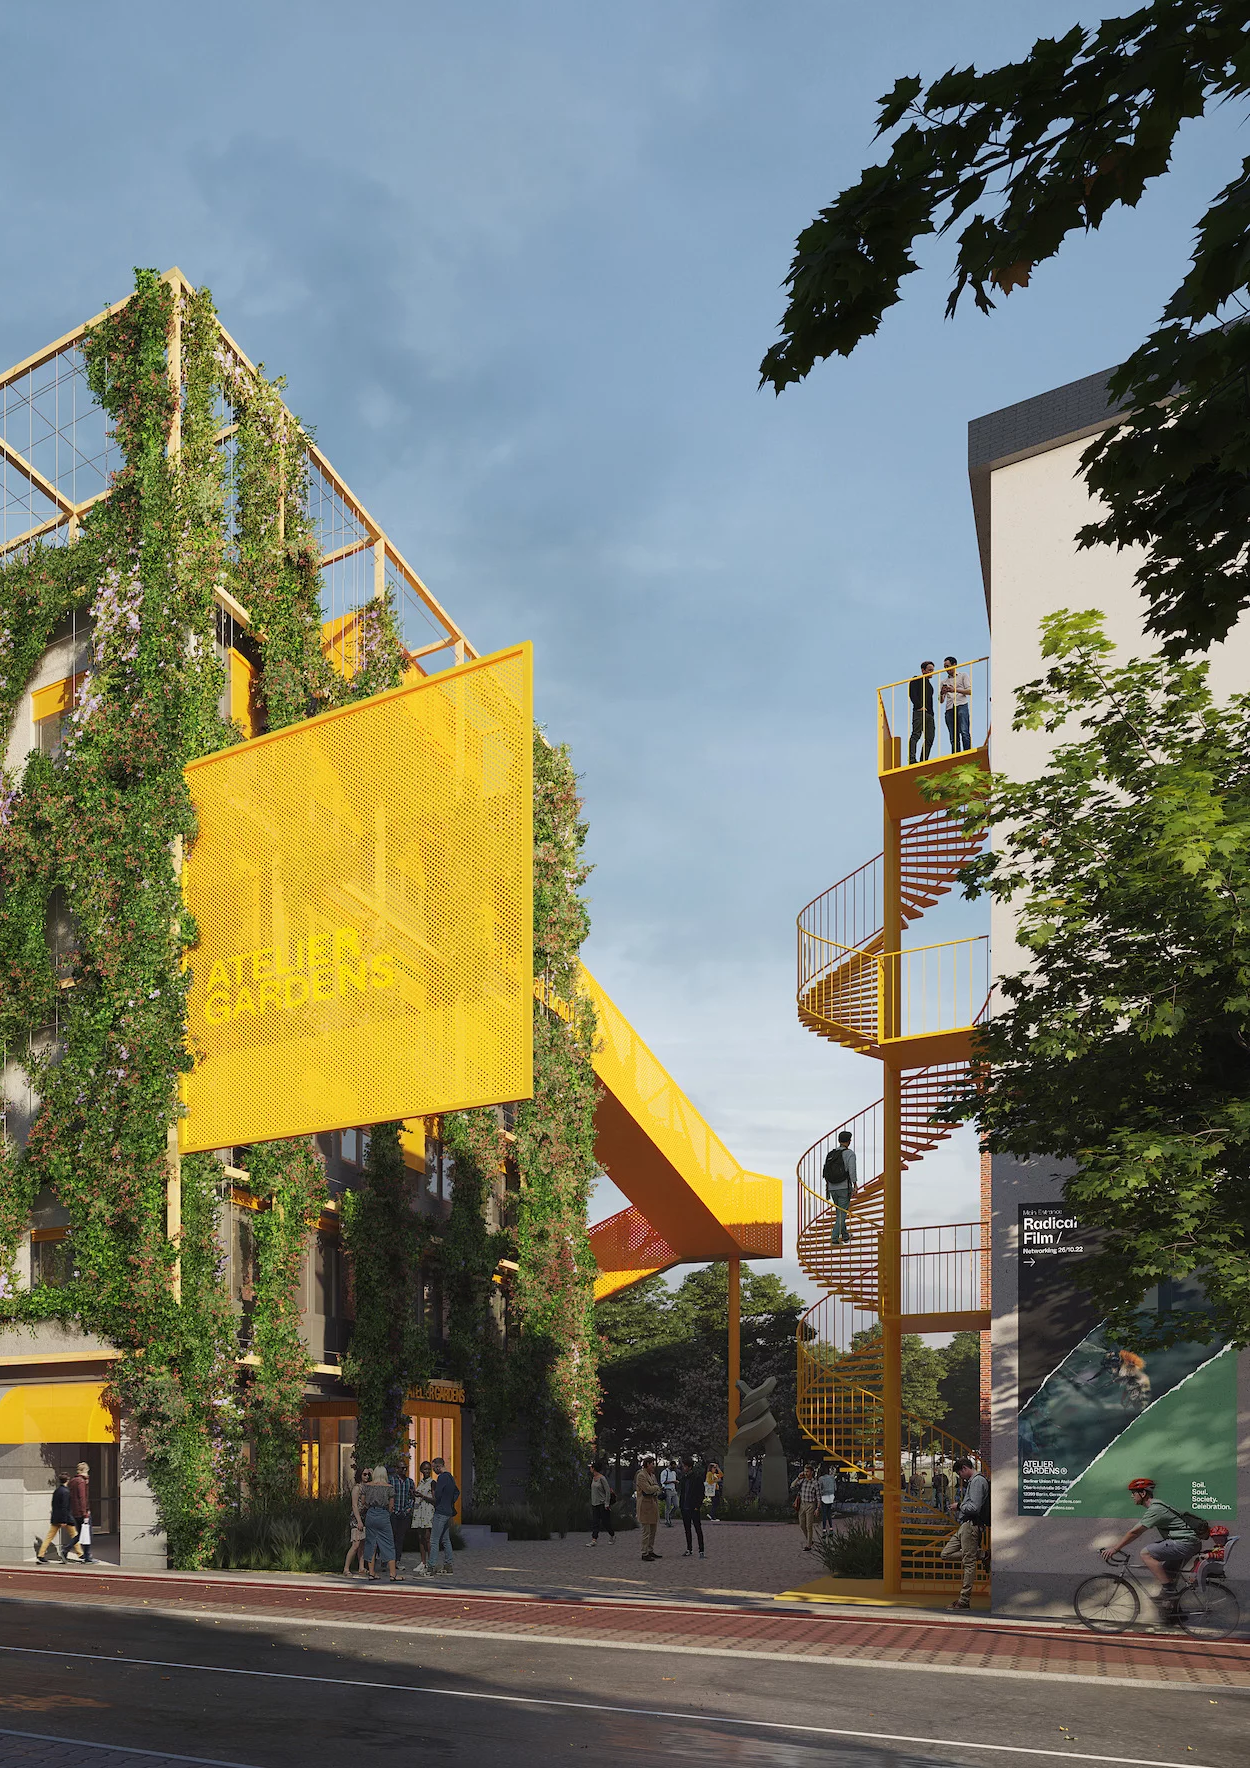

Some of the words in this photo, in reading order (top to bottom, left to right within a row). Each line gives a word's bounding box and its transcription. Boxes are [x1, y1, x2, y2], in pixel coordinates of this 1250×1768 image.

[206, 925, 362, 993] ATELIER
[205, 952, 396, 1026] GARDENS
[1023, 1215, 1078, 1230] Radical
[1023, 1231, 1054, 1245] Film
[1055, 1230, 1063, 1244] /
[1023, 1247, 1058, 1255] Networking
[435, 1385, 466, 1404] GARDENS
[1023, 1460, 1054, 1468] ATELIER
[1023, 1467, 1060, 1475] GARDENS
[1192, 1488, 1209, 1496] Soul.
[1192, 1495, 1219, 1504] Society.
[1192, 1502, 1232, 1510] Celebration.
